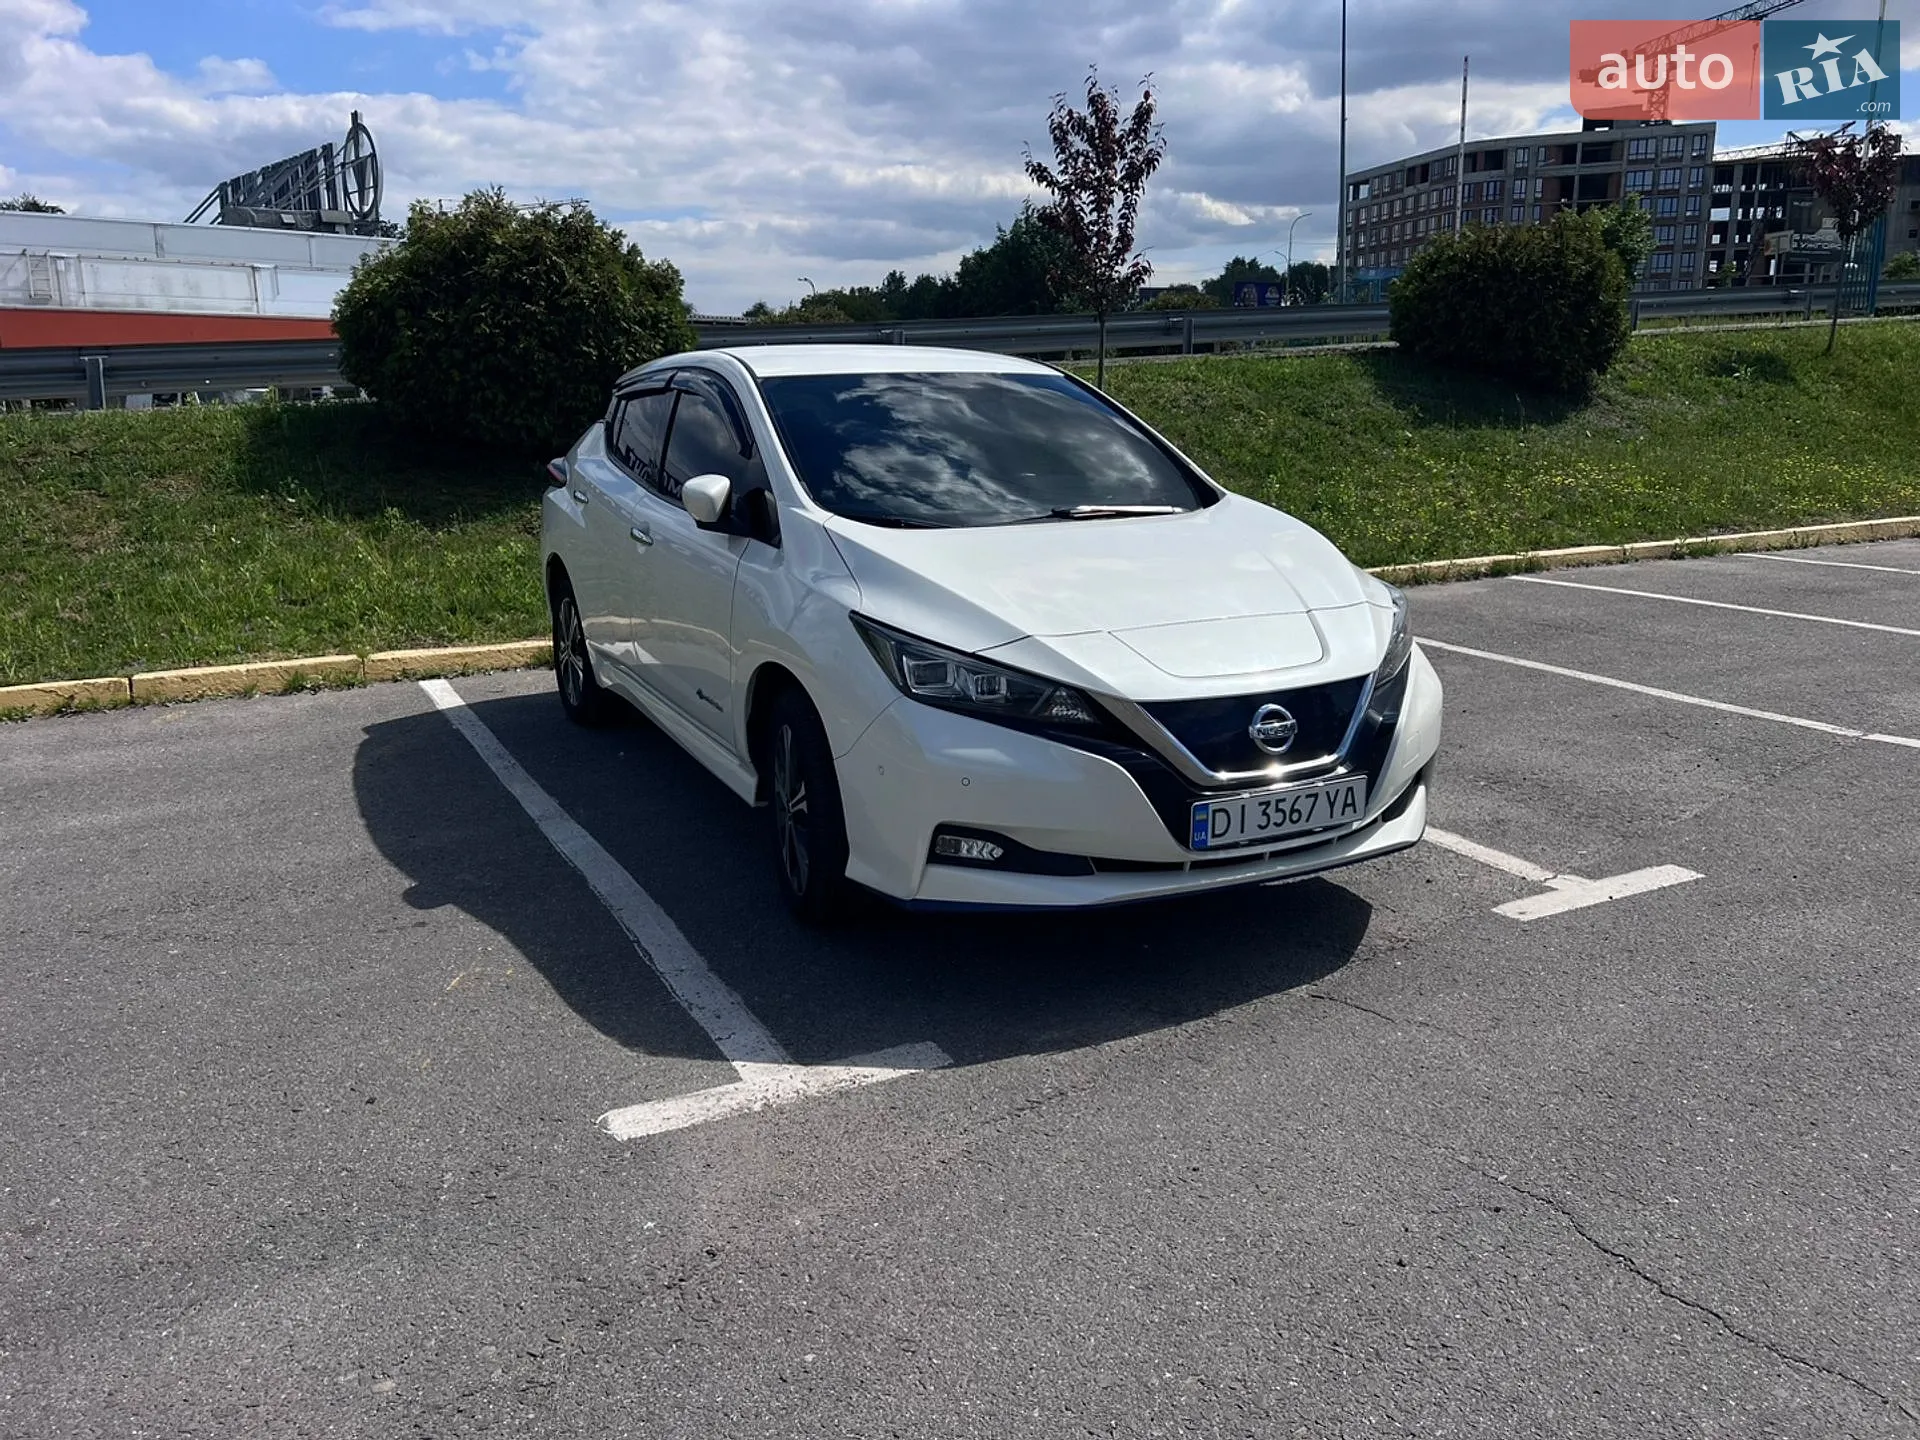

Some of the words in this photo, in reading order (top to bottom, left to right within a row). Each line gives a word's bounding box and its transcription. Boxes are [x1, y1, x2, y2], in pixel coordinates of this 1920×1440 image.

[1211, 804, 1246, 839] DI
[1257, 792, 1319, 830] 3567
[1326, 786, 1357, 819] YA
[1194, 833, 1207, 842] UA
